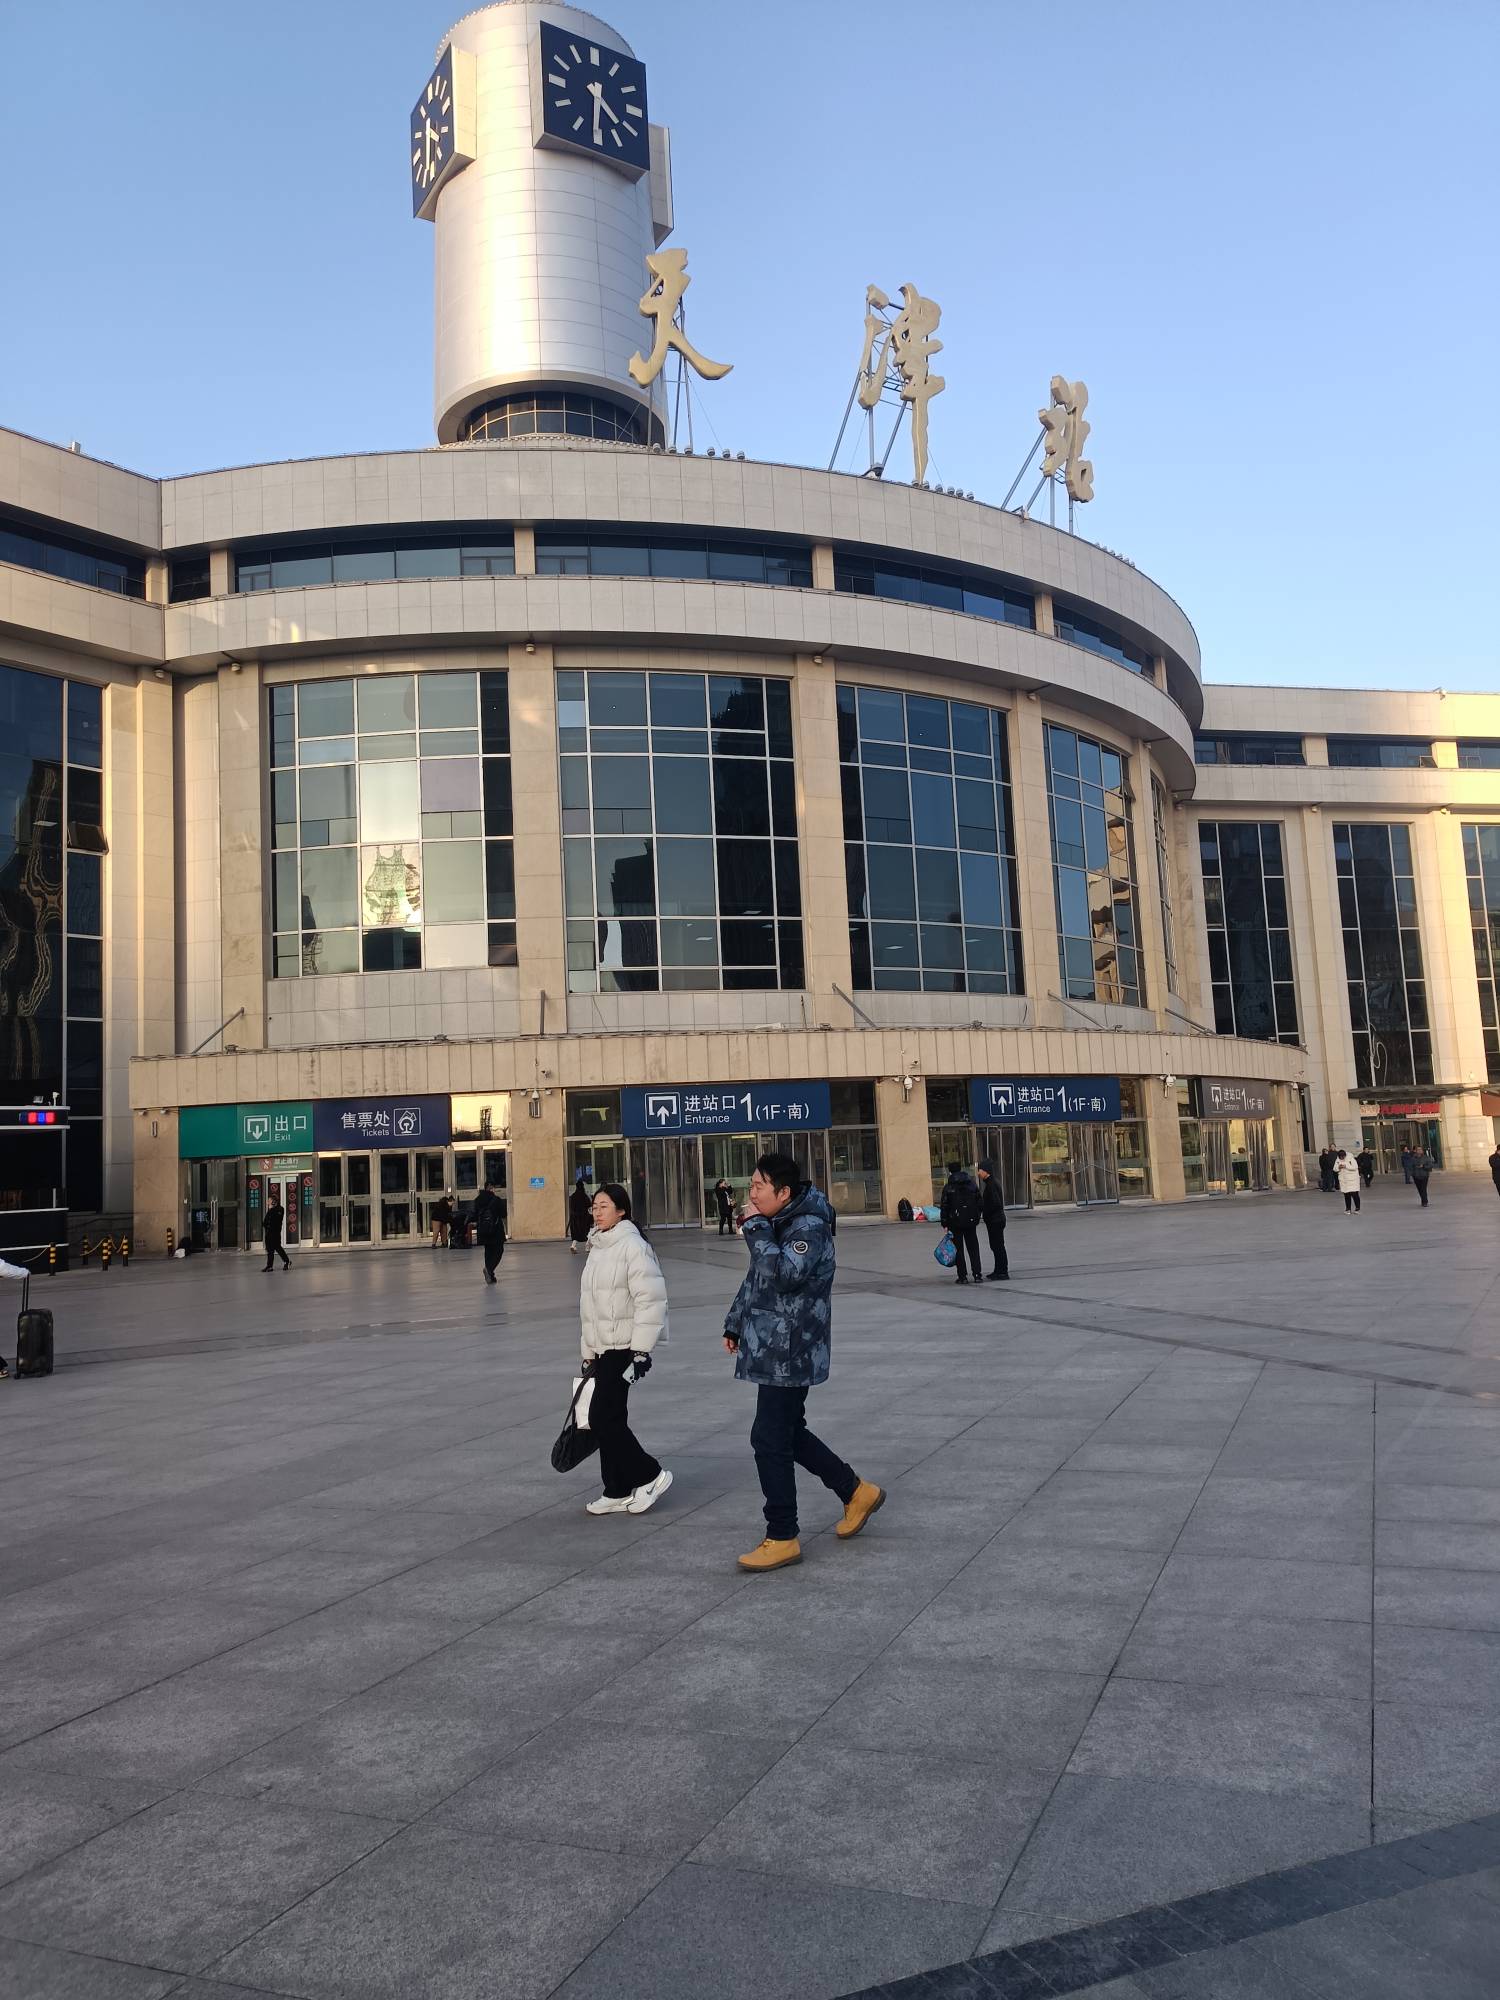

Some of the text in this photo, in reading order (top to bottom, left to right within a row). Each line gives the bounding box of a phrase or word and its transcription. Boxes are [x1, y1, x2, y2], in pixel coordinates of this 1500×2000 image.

[628, 247, 1094, 503] 天津站
[1017, 1104, 1051, 1114] Entrance
[274, 1114, 307, 1132] 出口
[340, 1110, 390, 1129] 售票处
[684, 1113, 730, 1124] Entrance
[274, 1133, 291, 1142] Exit
[361, 1128, 390, 1137] Tickets
